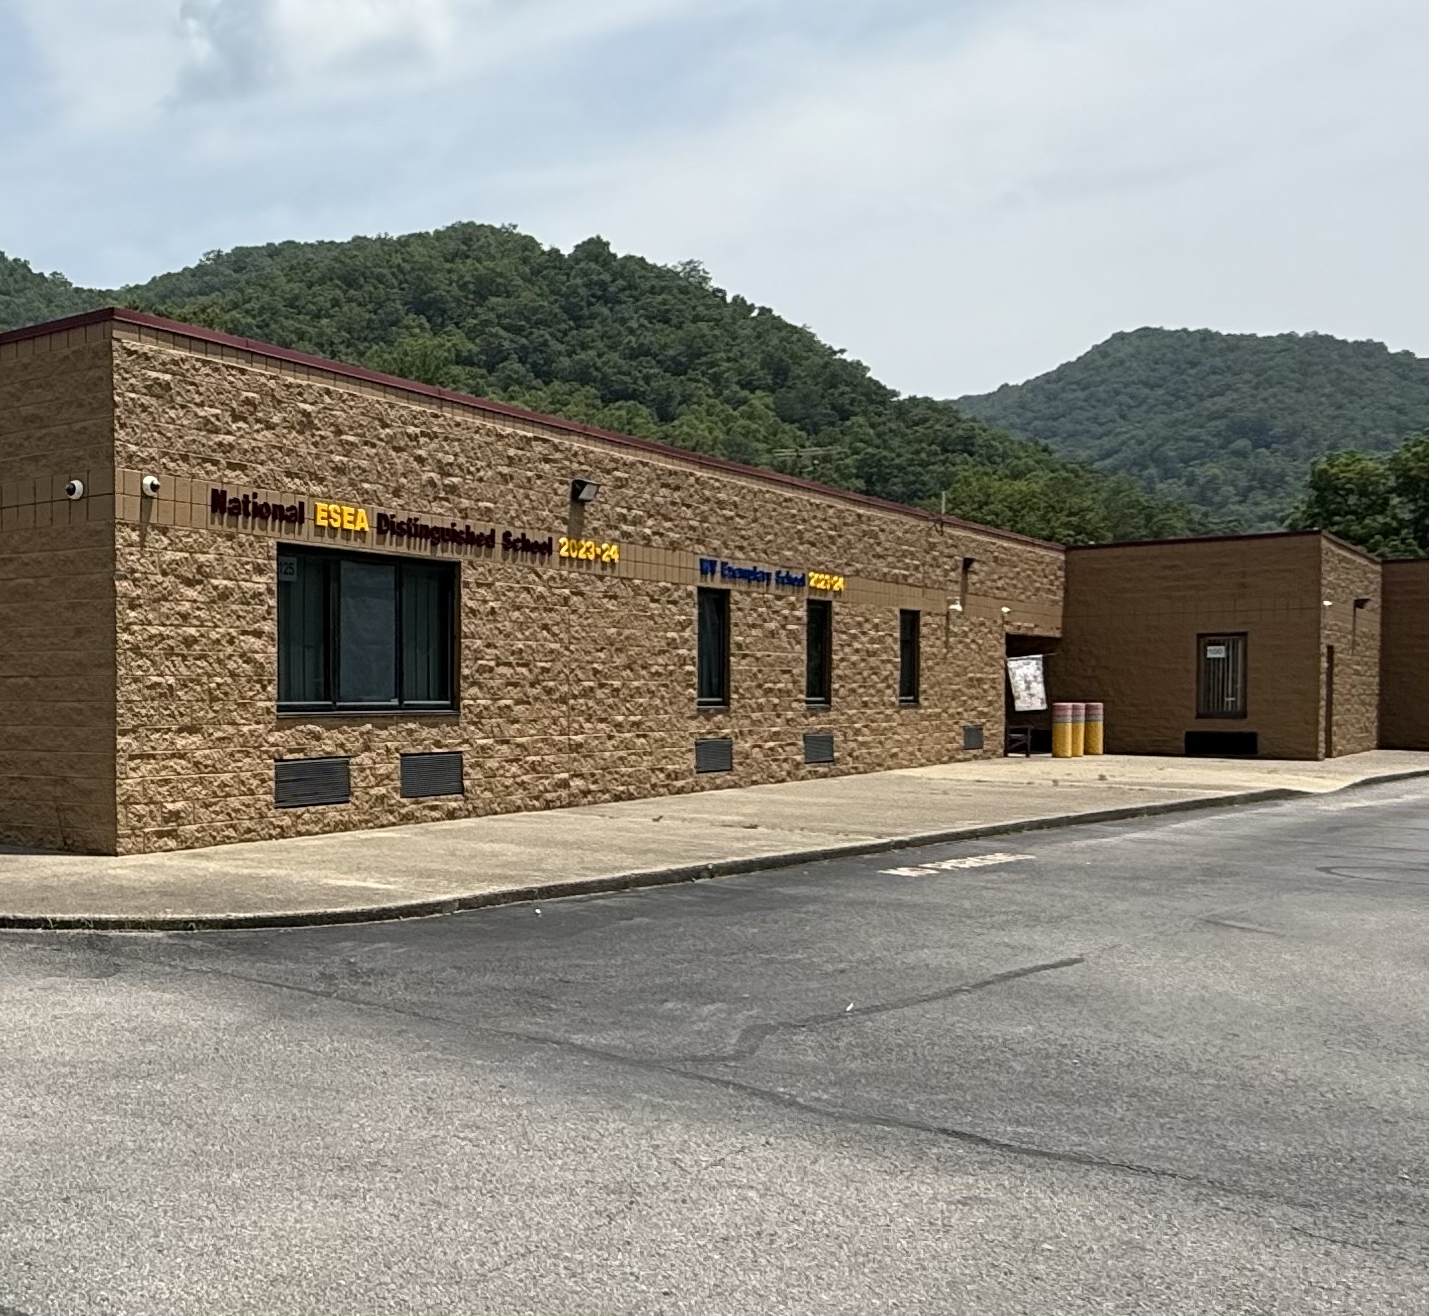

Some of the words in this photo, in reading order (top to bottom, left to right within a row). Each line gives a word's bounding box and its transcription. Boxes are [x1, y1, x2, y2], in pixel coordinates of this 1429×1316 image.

[211, 487, 305, 525] National
[314, 501, 369, 532] ESEA
[377, 512, 495, 549] Distinguished
[502, 529, 553, 557] School
[558, 536, 619, 564] 2023-24
[280, 561, 295, 576] 125
[774, 570, 806, 587] School
